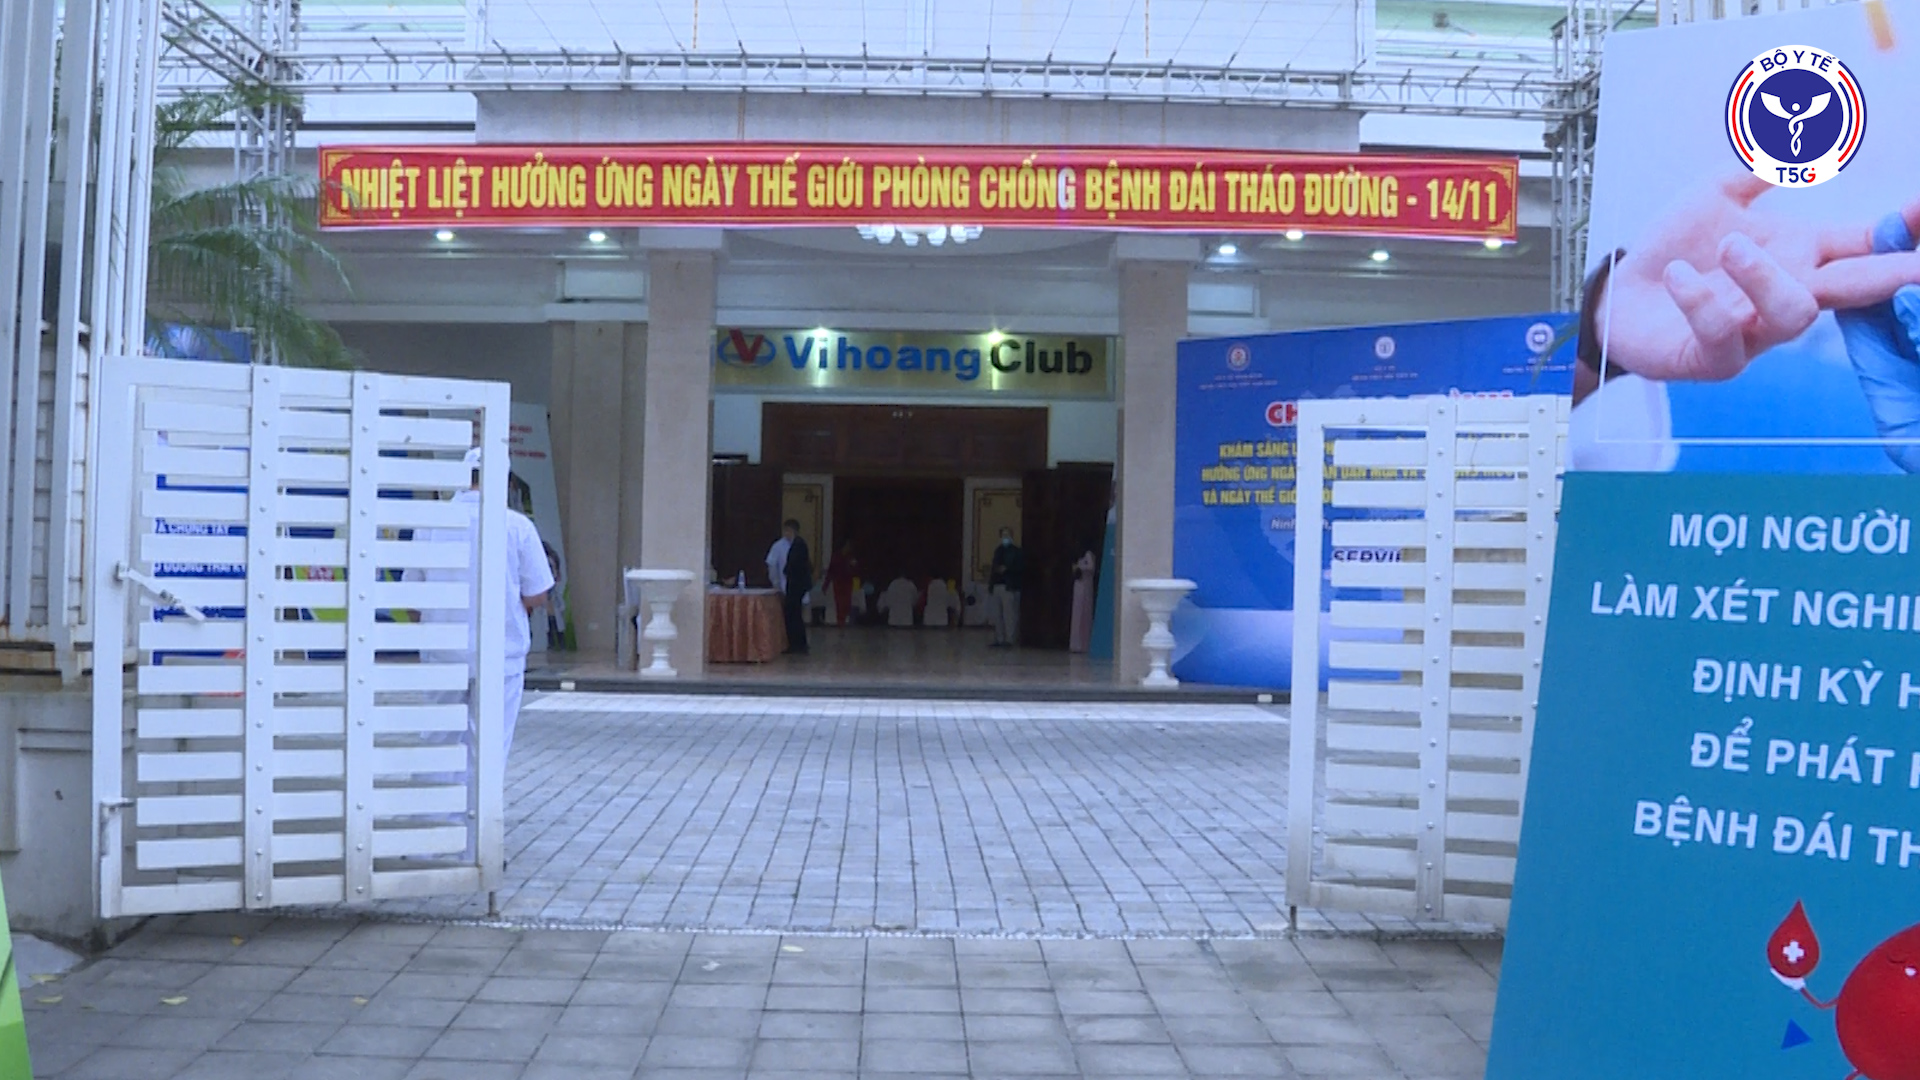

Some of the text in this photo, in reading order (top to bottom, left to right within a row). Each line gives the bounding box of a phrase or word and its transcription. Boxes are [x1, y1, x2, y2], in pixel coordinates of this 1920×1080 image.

[341, 159, 420, 218] NHIỆT
[428, 158, 481, 218] LIỆT
[492, 152, 586, 208] HƯỞNG
[596, 156, 651, 208] ỨNG
[662, 156, 738, 207] NGÀY
[746, 152, 797, 207] THẾ
[808, 156, 863, 207] GIỚI
[873, 156, 969, 208] PHÒNG
[979, 152, 1075, 209] CHỐNG
[1086, 159, 1161, 220] BỆNH
[1169, 162, 1215, 213] ĐÁI
[1224, 164, 1295, 214] THÁO
[1303, 165, 1398, 217] ĐƯỜNG
[1427, 178, 1498, 221] 14/11
[989, 339, 1093, 374] Club
[1669, 509, 1910, 556] MỌI NGƯỜI
[1590, 572, 1920, 632] LÀM XÉT NGHI
[1693, 658, 1802, 703] ĐỊNH
[1818, 659, 1884, 706] KỲ
[1690, 716, 1754, 772] ĐỂ
[1765, 735, 1895, 785] PHÁT
[1633, 795, 1759, 849] BỆNH
[1773, 812, 1852, 861] ĐÁI
